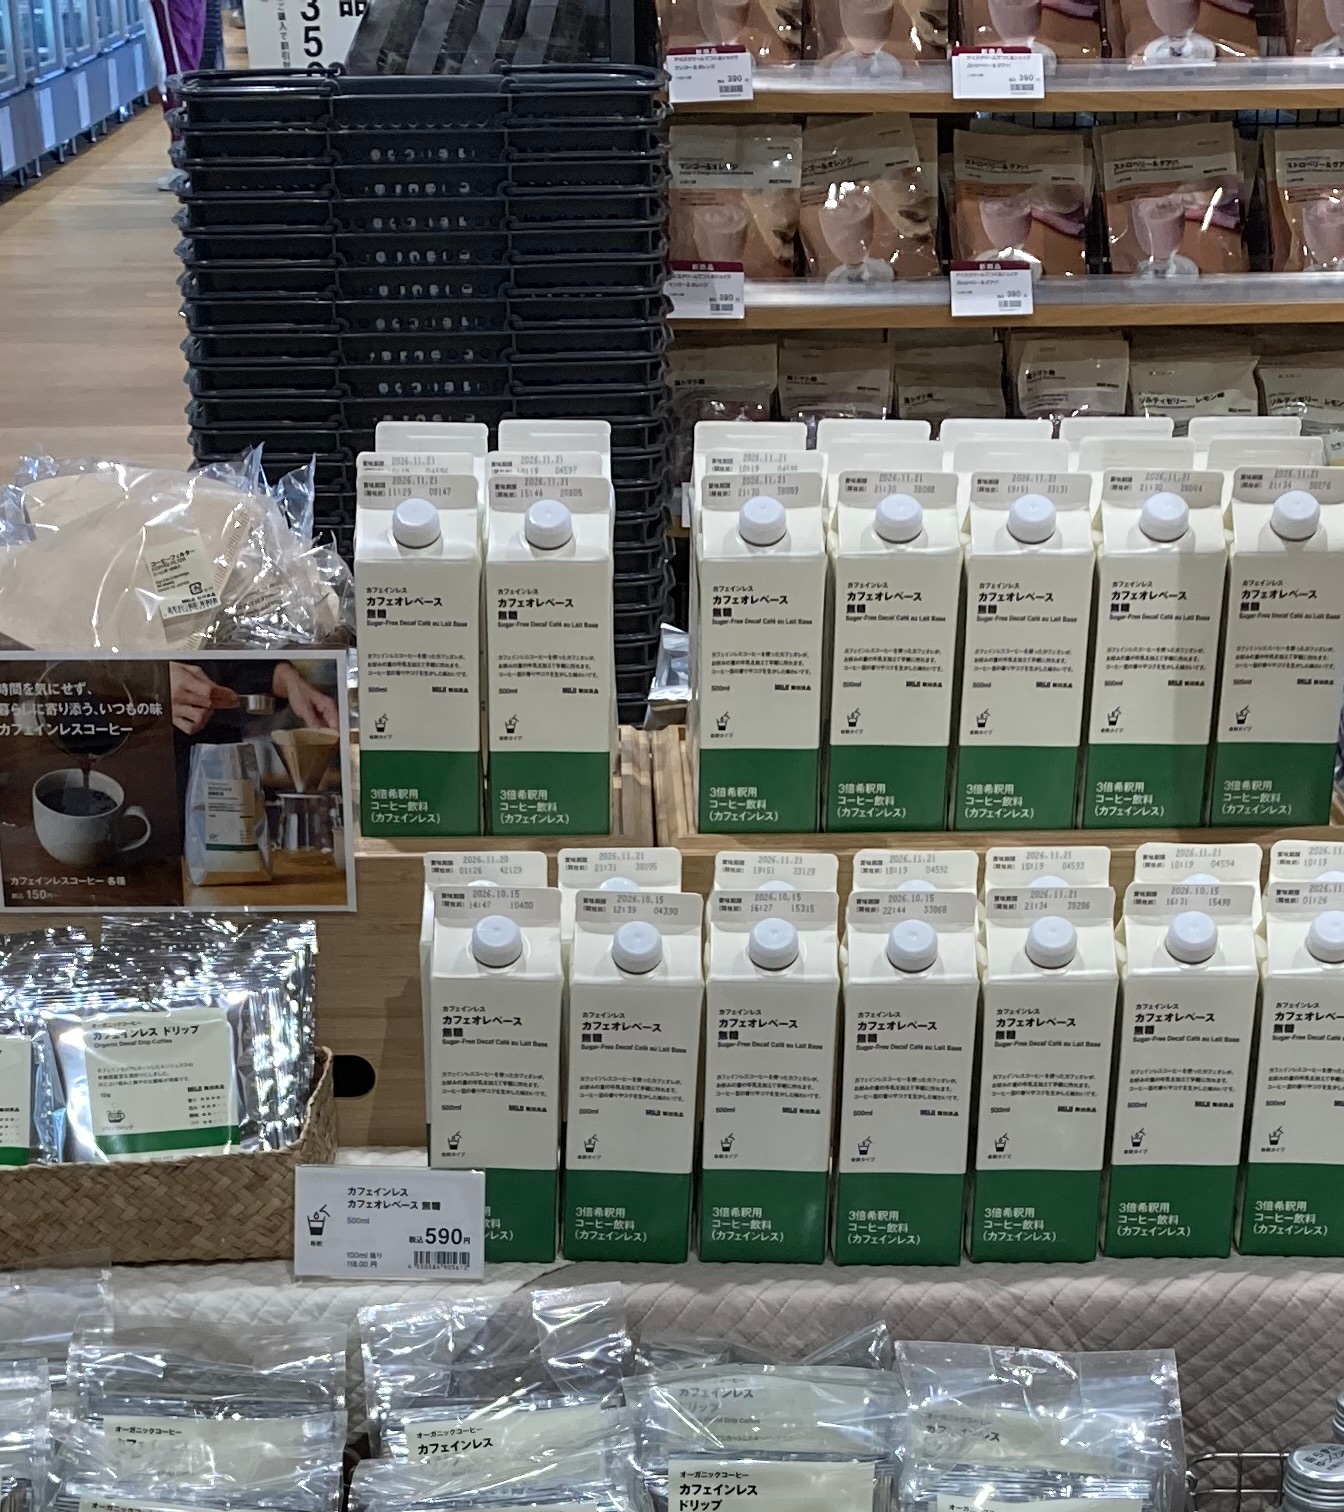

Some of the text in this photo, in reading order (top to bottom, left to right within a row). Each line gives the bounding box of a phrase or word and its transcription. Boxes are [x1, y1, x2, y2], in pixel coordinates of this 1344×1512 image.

[713, 594, 788, 606] カフェオレベース
[847, 590, 922, 602] カフェオレベース
[979, 591, 1054, 602] カフェオレベース
[1111, 590, 1187, 601] カフェオレベース
[1242, 589, 1317, 600] カフェオレベース
[366, 595, 443, 607] カフェオレベース
[498, 596, 574, 608] カフェオレベース
[0, 723, 132, 736] カフェインレスコーヒー
[965, 796, 1023, 806] コーヒー飲料
[1223, 792, 1281, 803] コーヒー飲料
[500, 801, 558, 812] コーヒー飲料
[709, 799, 767, 810] コーヒー飲料
[10, 876, 105, 886] カフェインレスコーヒー
[442, 1015, 522, 1027] カフェオレベース
[996, 1017, 1076, 1028] カフェオレベース
[1134, 1012, 1215, 1023] カフェオレベース
[582, 1021, 662, 1033] カフェオレベース
[719, 1018, 798, 1029] カフェオレベース
[858, 1021, 937, 1032] カフェオレベース
[163, 1025, 199, 1036] ドリップ
[348, 1187, 408, 1196] カフェインレス
[348, 1200, 418, 1210] カフェオレベース
[1118, 1214, 1179, 1225] コーヒー飲料
[1254, 1212, 1316, 1224] コーヒー飲料
[576, 1219, 635, 1230] コーヒー飲料
[712, 1219, 772, 1230] コーヒー飲料
[984, 1219, 1045, 1231] コーヒー飲料
[418, 1438, 493, 1455] カフェインレス
[680, 1471, 749, 1479] オーガニックコーヒー
[679, 1484, 758, 1496] カフェインレス
[679, 1500, 723, 1512] ドリップ
